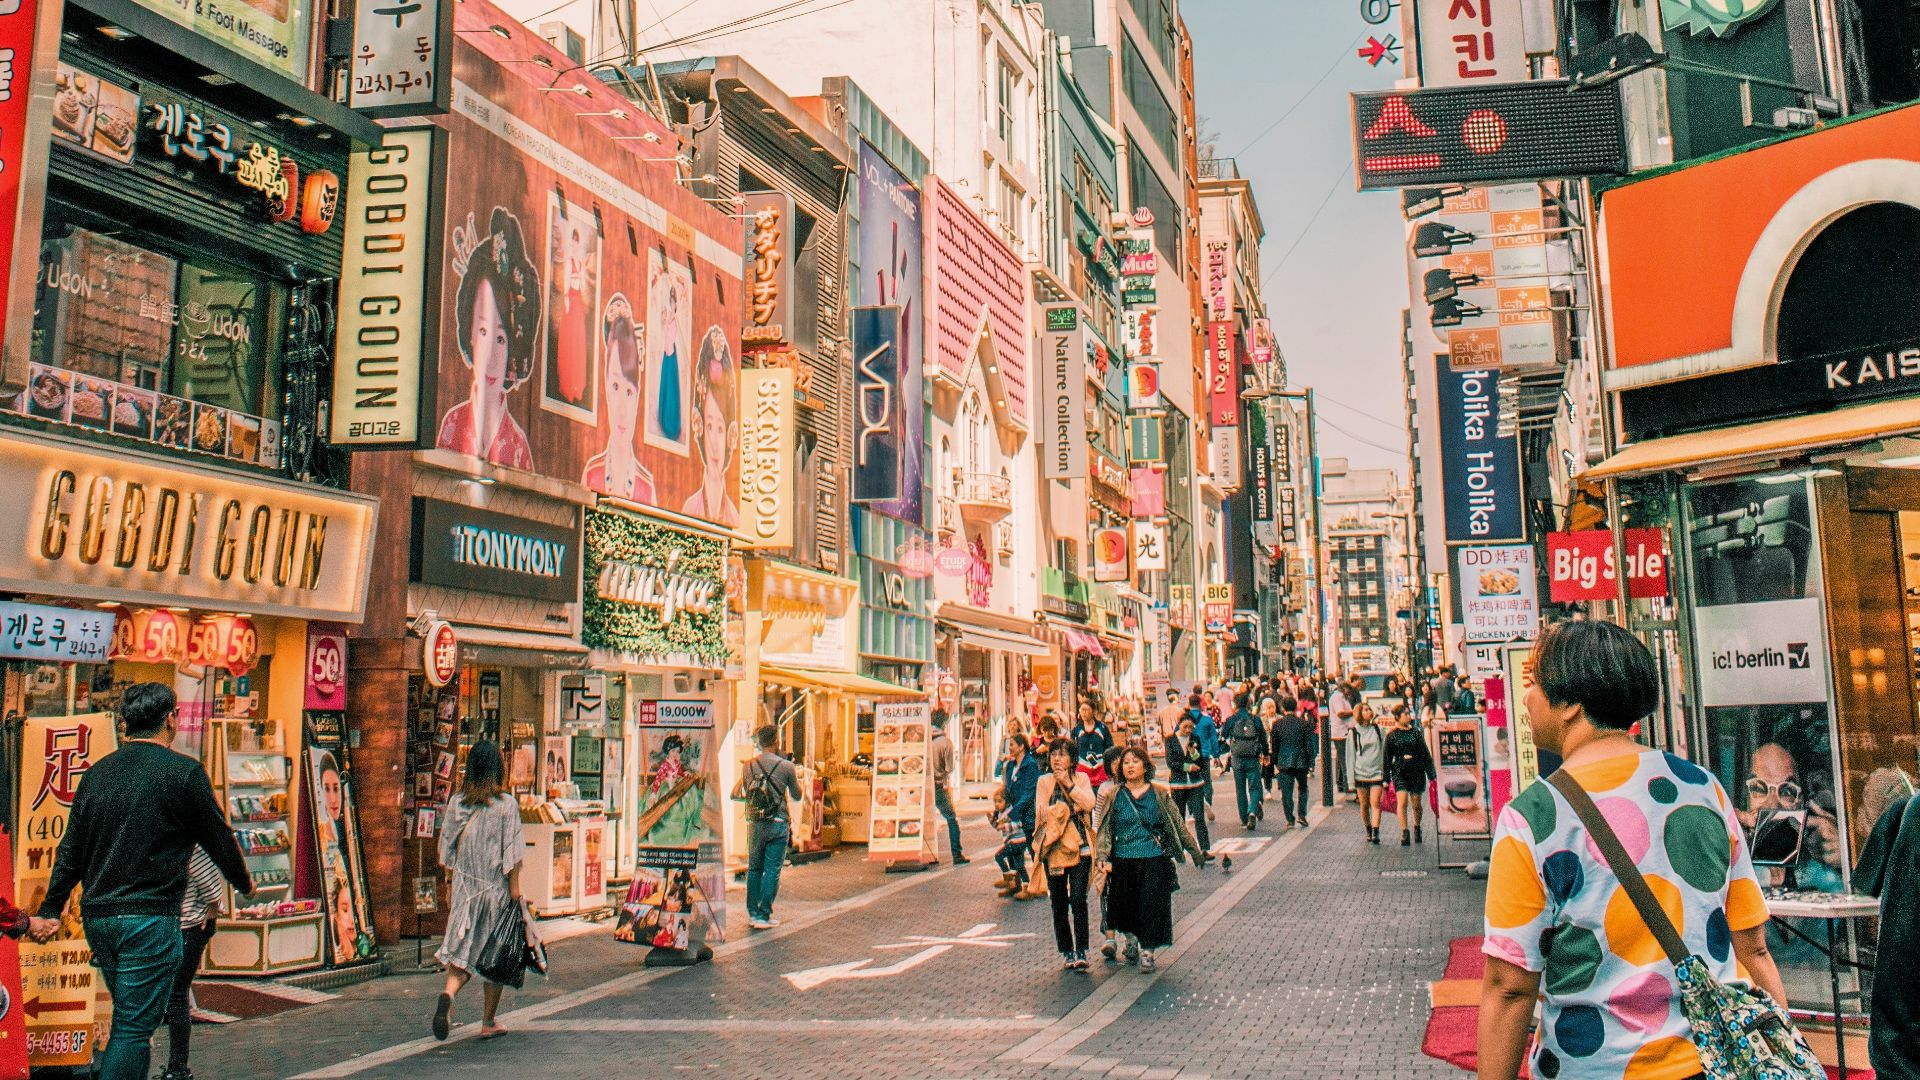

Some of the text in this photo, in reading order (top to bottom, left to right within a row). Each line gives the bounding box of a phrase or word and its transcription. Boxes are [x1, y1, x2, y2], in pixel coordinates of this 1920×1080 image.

[207, 5, 235, 32] Foot
[238, 17, 289, 59] Massage
[356, 71, 431, 95] 꼬치구이
[154, 103, 236, 174] 겐로쿠
[354, 143, 409, 410] GOBDI GOUN
[1121, 256, 1157, 273] Mud
[1454, 341, 1496, 354] style
[1455, 353, 1497, 365] mall
[1215, 375, 1226, 393] 2
[1826, 348, 1920, 389] KAIS
[859, 341, 891, 468] VDL
[1056, 335, 1071, 472] Nature Collection
[348, 420, 401, 438] 곱디고운
[756, 377, 781, 539] SKINFOOD
[1258, 489, 1268, 520] COFFEE
[1466, 451, 1496, 536] Holika
[40, 470, 328, 591] GOBDI GOUN
[1138, 534, 1160, 559] 光
[461, 524, 567, 578] TONYMOLY
[939, 556, 967, 566] ETUDE
[1466, 550, 1493, 566] DD
[1554, 547, 1597, 589] Big
[882, 570, 912, 609] VDL
[1208, 587, 1229, 599] BIG
[1207, 604, 1229, 618] MART
[7, 613, 67, 653] 겐로쿠
[145, 621, 178, 659] 50
[189, 625, 220, 661] 50
[227, 627, 256, 663] 50
[313, 648, 341, 682] 50
[1712, 647, 1785, 670] ic! berlin
[31, 723, 92, 812] 足
[26, 1030, 70, 1055] 5-4455
[71, 1031, 87, 1052] 3F
